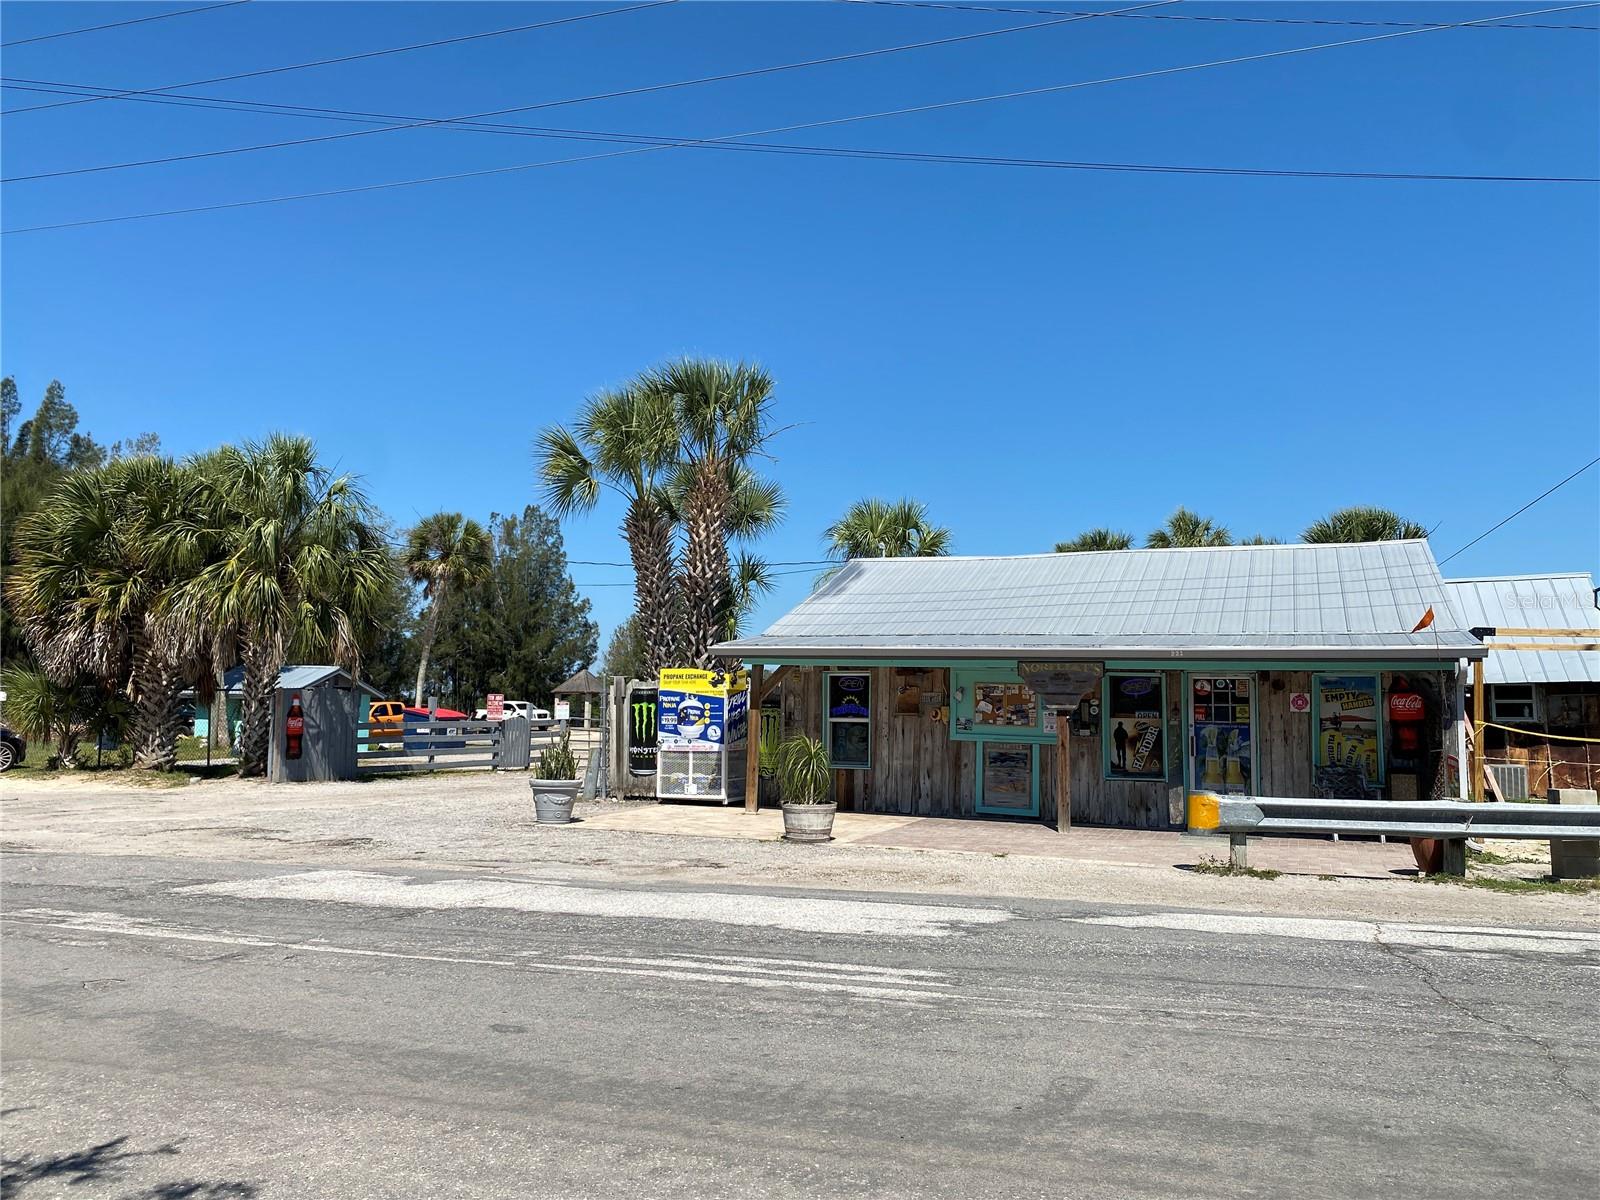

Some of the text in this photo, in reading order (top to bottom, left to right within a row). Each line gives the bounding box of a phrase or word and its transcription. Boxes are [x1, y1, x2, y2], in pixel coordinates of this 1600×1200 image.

[840, 679, 864, 689] OPEN
[1325, 692, 1357, 703] EMPTY
[1390, 695, 1422, 709] Coca-Cola
[1344, 699, 1373, 710] HANDED
[630, 746, 661, 754] MONSTE
[1132, 726, 1160, 770] HARDER
